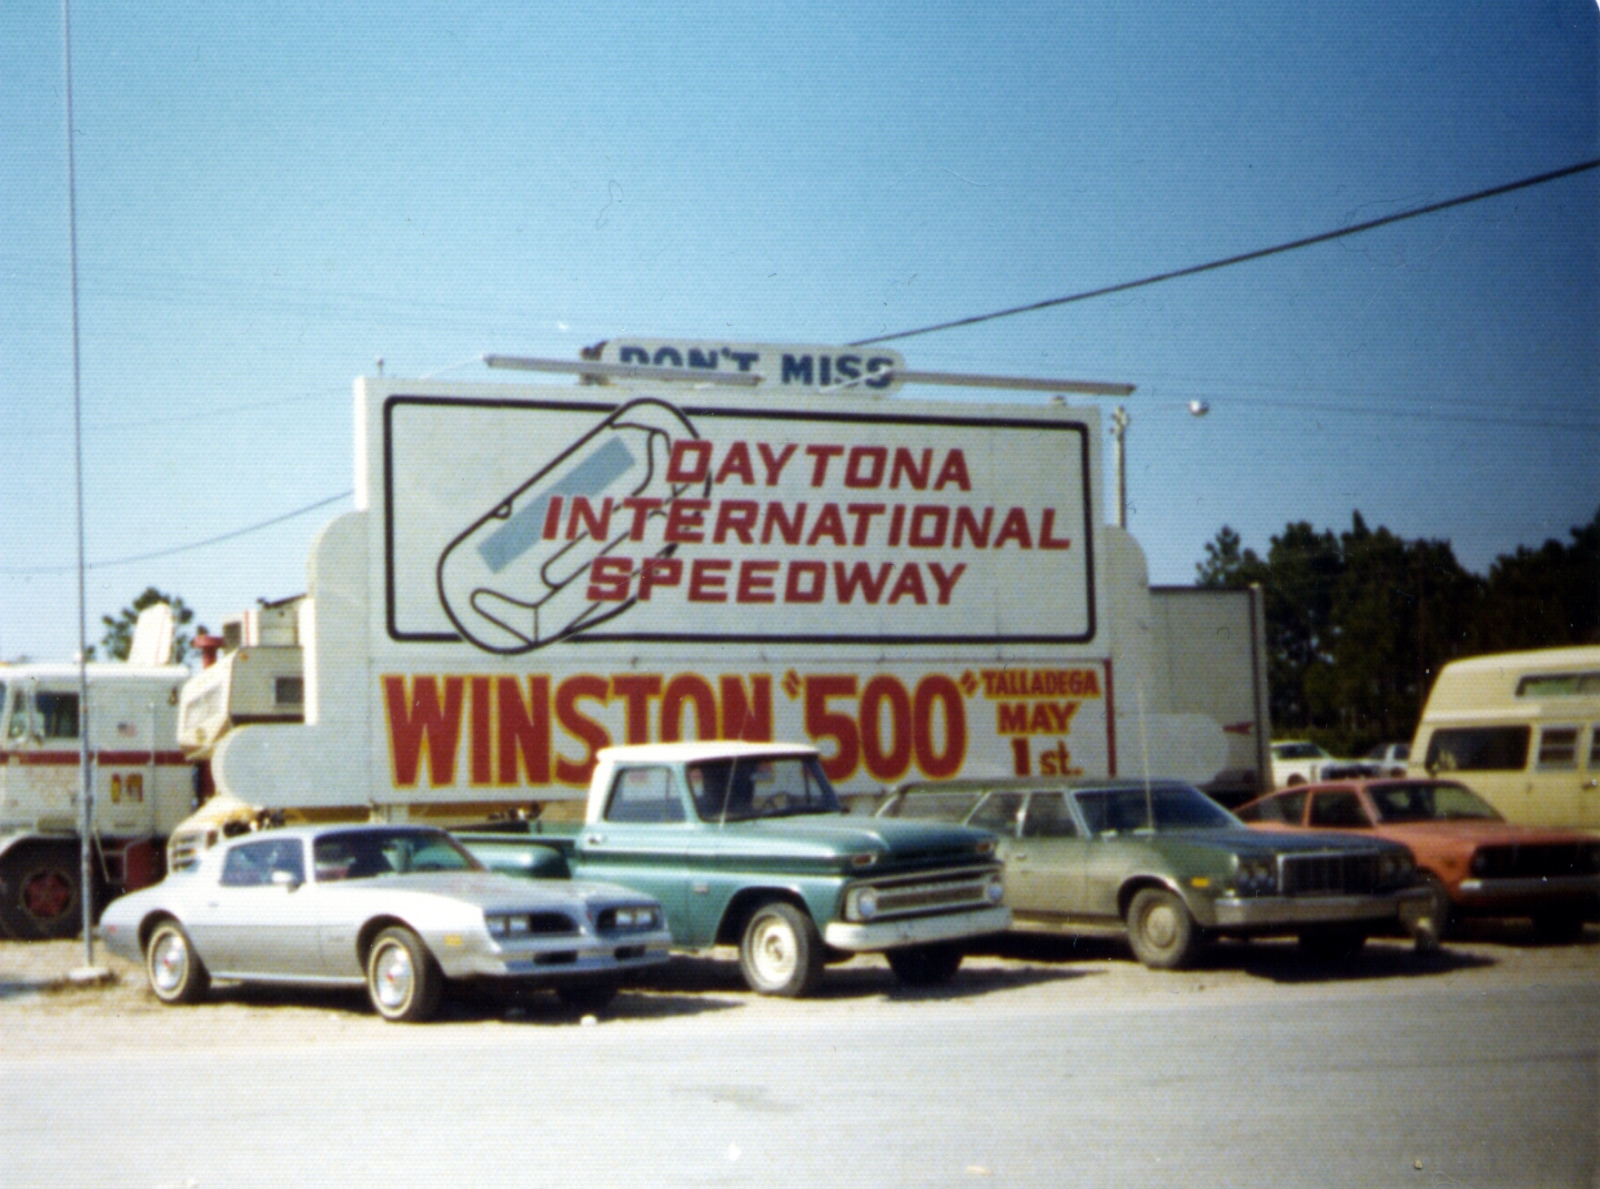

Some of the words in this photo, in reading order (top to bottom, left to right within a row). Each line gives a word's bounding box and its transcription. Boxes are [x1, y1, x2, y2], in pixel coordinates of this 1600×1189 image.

[620, 347, 759, 371] DON'T
[782, 354, 894, 388] MISS
[666, 440, 972, 491] DAYTONA
[542, 496, 1071, 550] INTERNATIONAL
[586, 557, 967, 605] SPEEDWAY
[979, 668, 1101, 699] TALLADEGA
[380, 672, 774, 789] WINSTON
[996, 701, 1081, 735] MAY
